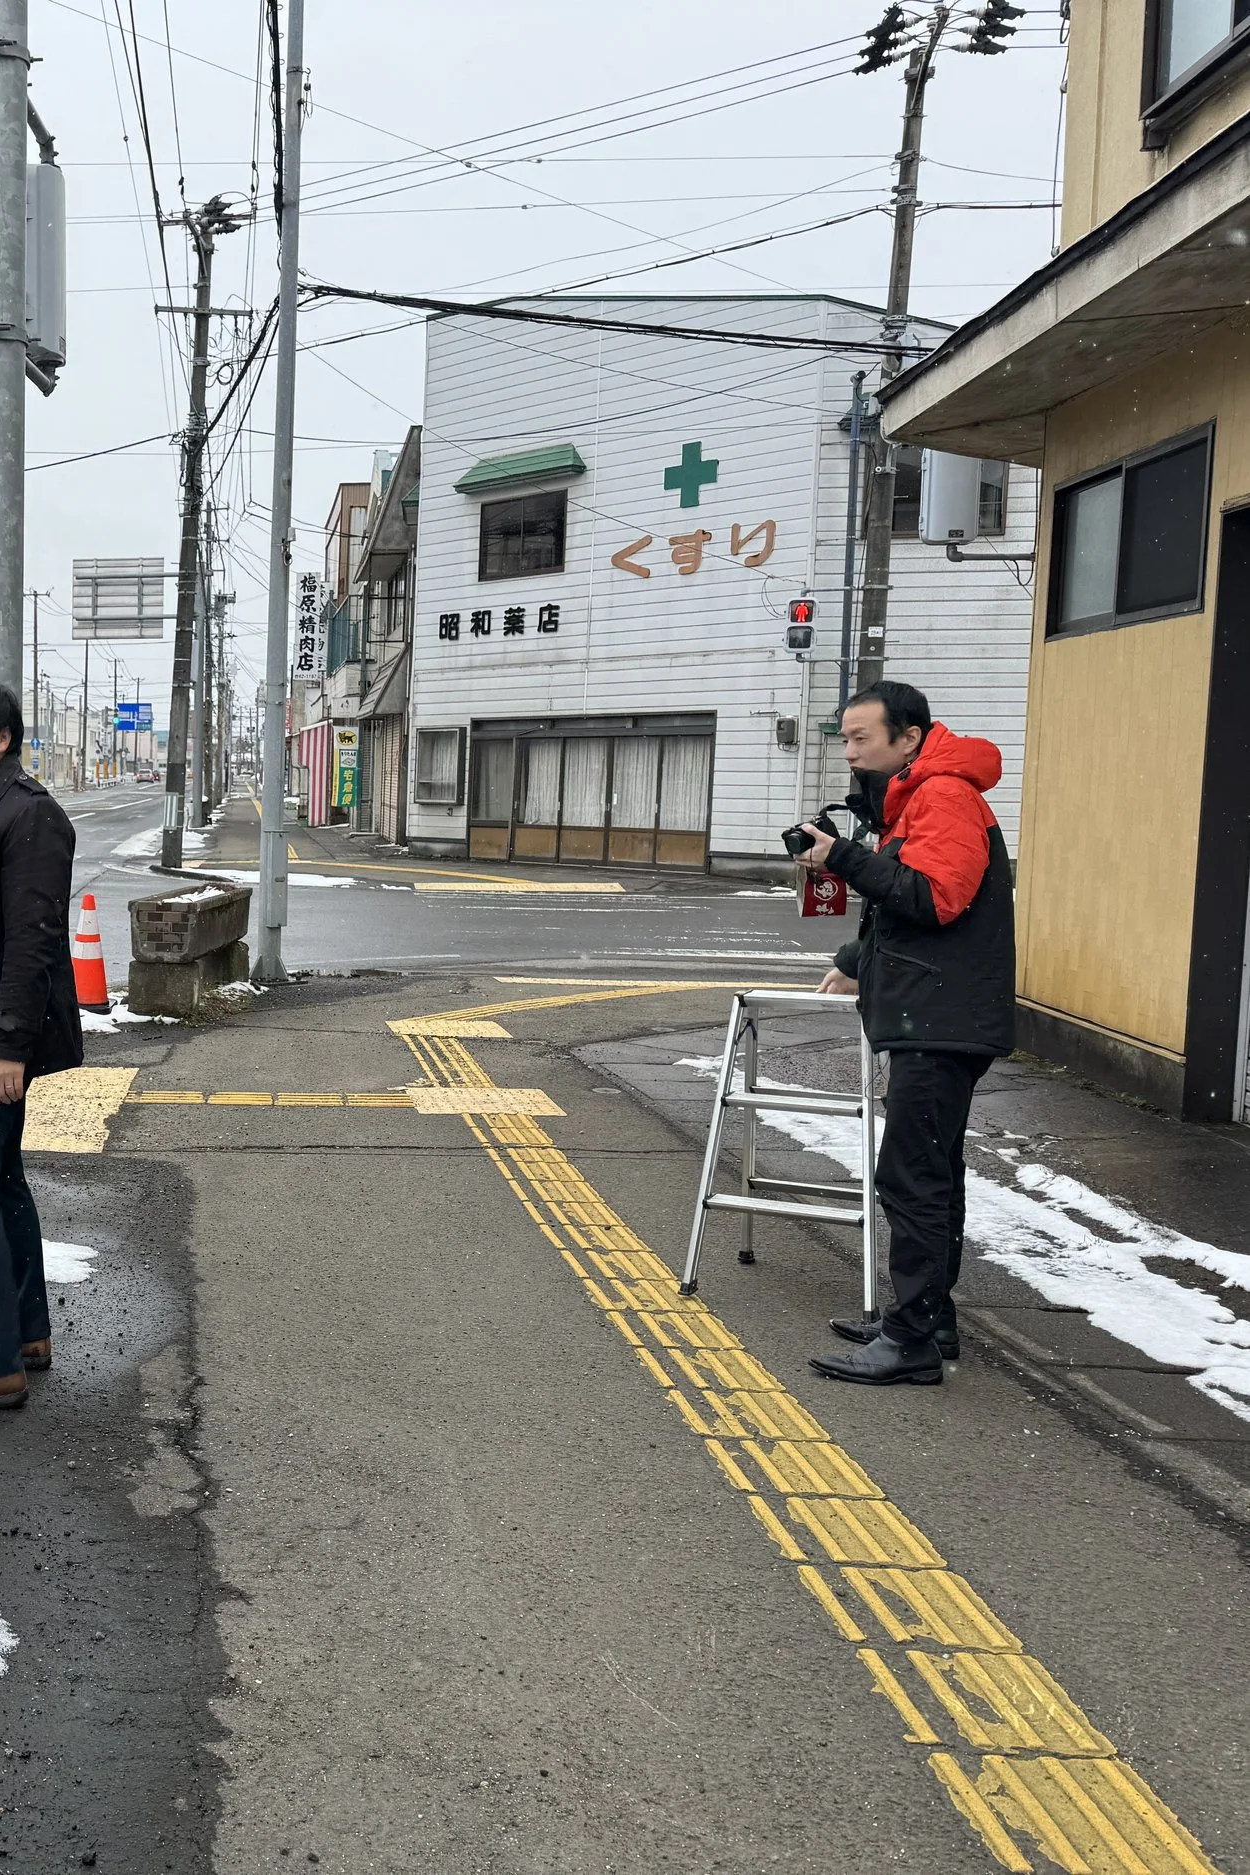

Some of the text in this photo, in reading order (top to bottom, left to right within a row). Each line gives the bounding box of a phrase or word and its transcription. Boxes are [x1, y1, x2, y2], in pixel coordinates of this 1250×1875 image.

[611, 519, 776, 578] くすり
[297, 573, 317, 671] 福原精肉店
[439, 603, 560, 640] 昭和薬店
